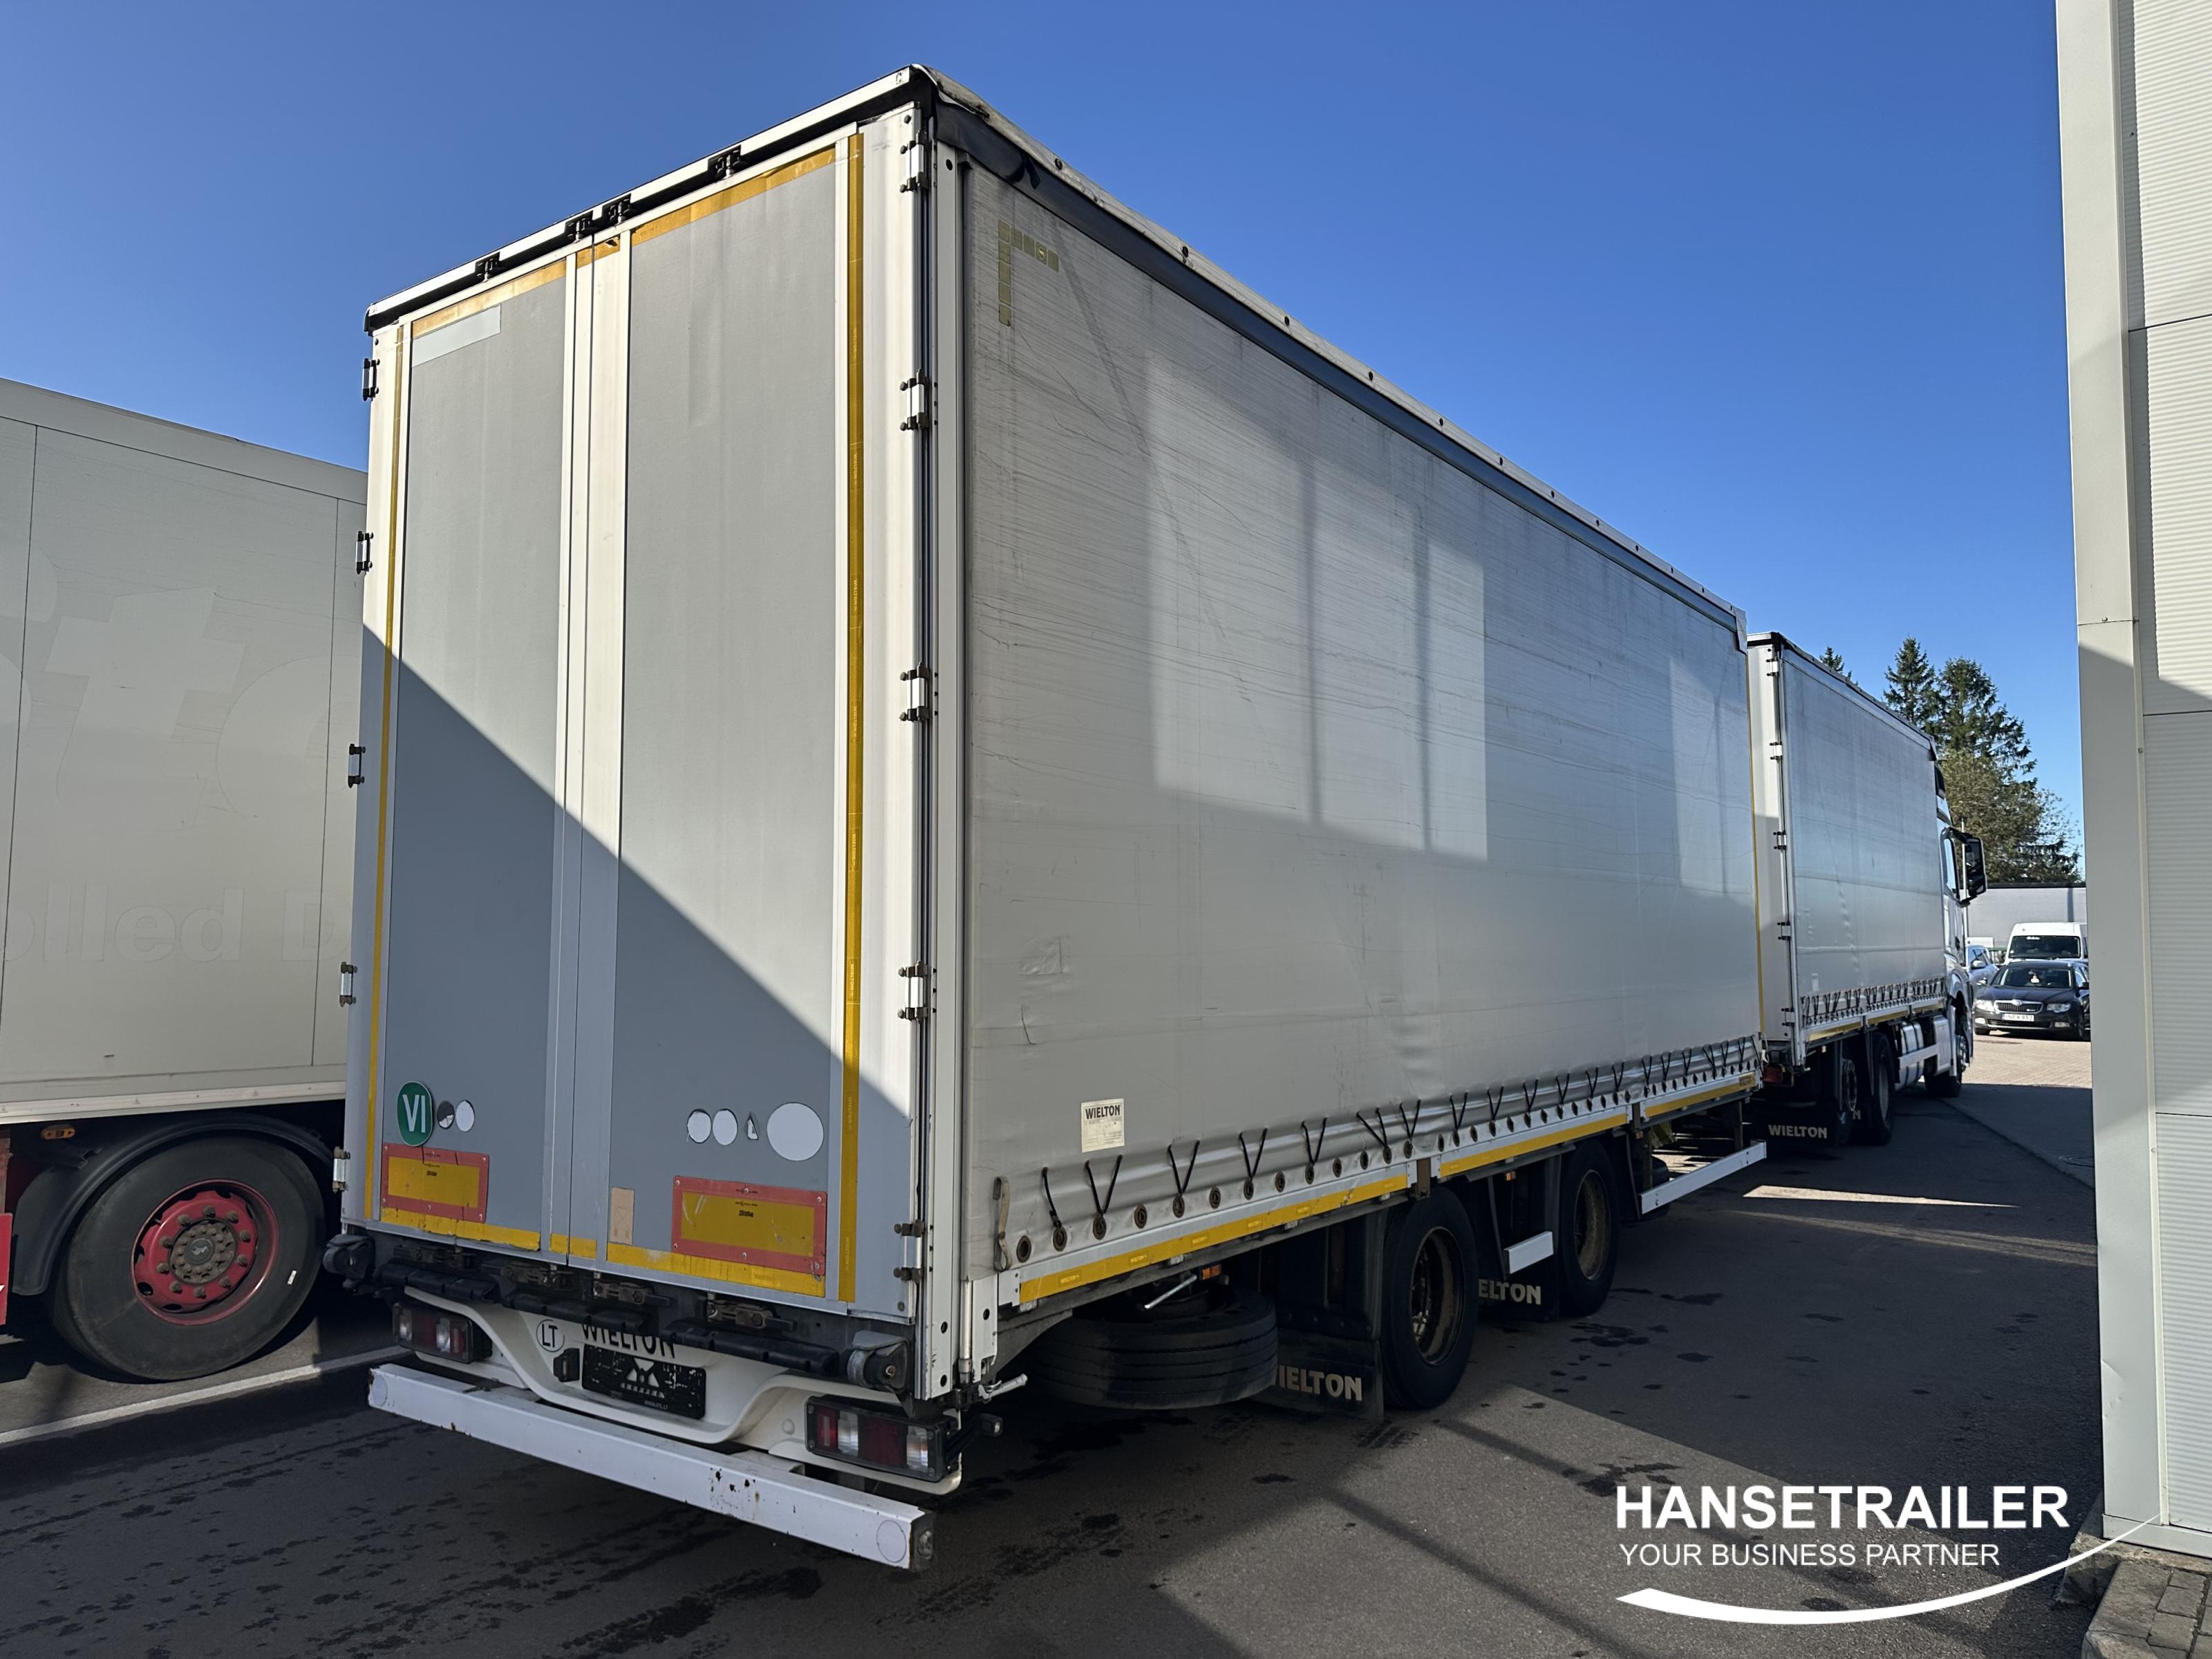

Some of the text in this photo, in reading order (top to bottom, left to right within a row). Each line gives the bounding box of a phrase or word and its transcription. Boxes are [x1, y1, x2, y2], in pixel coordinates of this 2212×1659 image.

[402, 1094, 426, 1133] VI
[1085, 1105, 1121, 1120] WIELTON
[1768, 1125, 1828, 1139] WIELTON
[1479, 1279, 1541, 1305] ELTON
[542, 1324, 558, 1347] LT
[582, 1323, 675, 1359] WIELTON
[1277, 1365, 1362, 1401] IELTON
